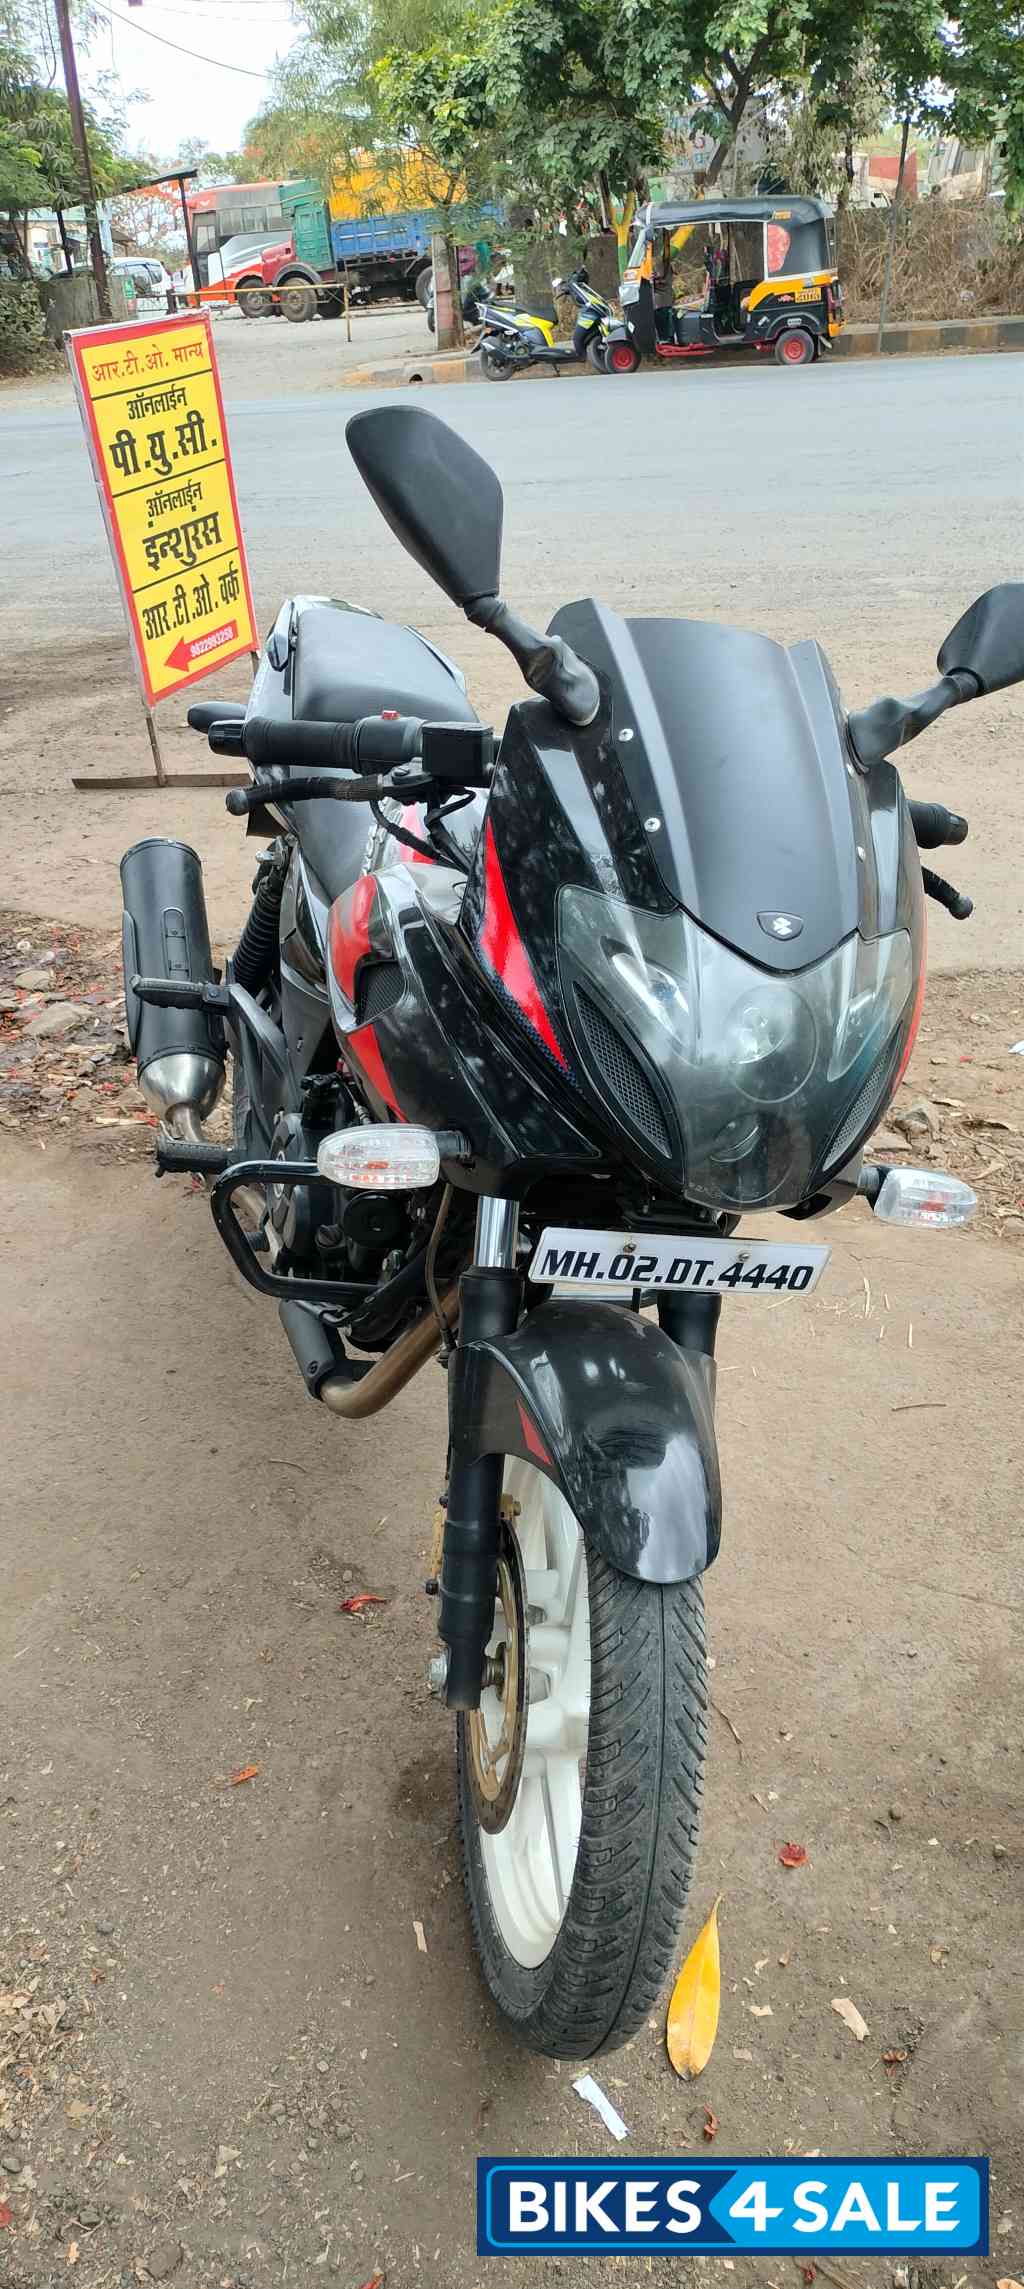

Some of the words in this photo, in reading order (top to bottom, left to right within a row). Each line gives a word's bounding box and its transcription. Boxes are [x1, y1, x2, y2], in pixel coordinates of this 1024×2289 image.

[172, 341, 204, 367] मान्य
[126, 385, 187, 420] ऑनलाईन
[109, 409, 218, 477] पी.यु.सी.
[146, 480, 203, 518] ऑनलाईन
[218, 561, 240, 605] वर्क
[541, 1249, 814, 1291] MH.02.DT.4440
